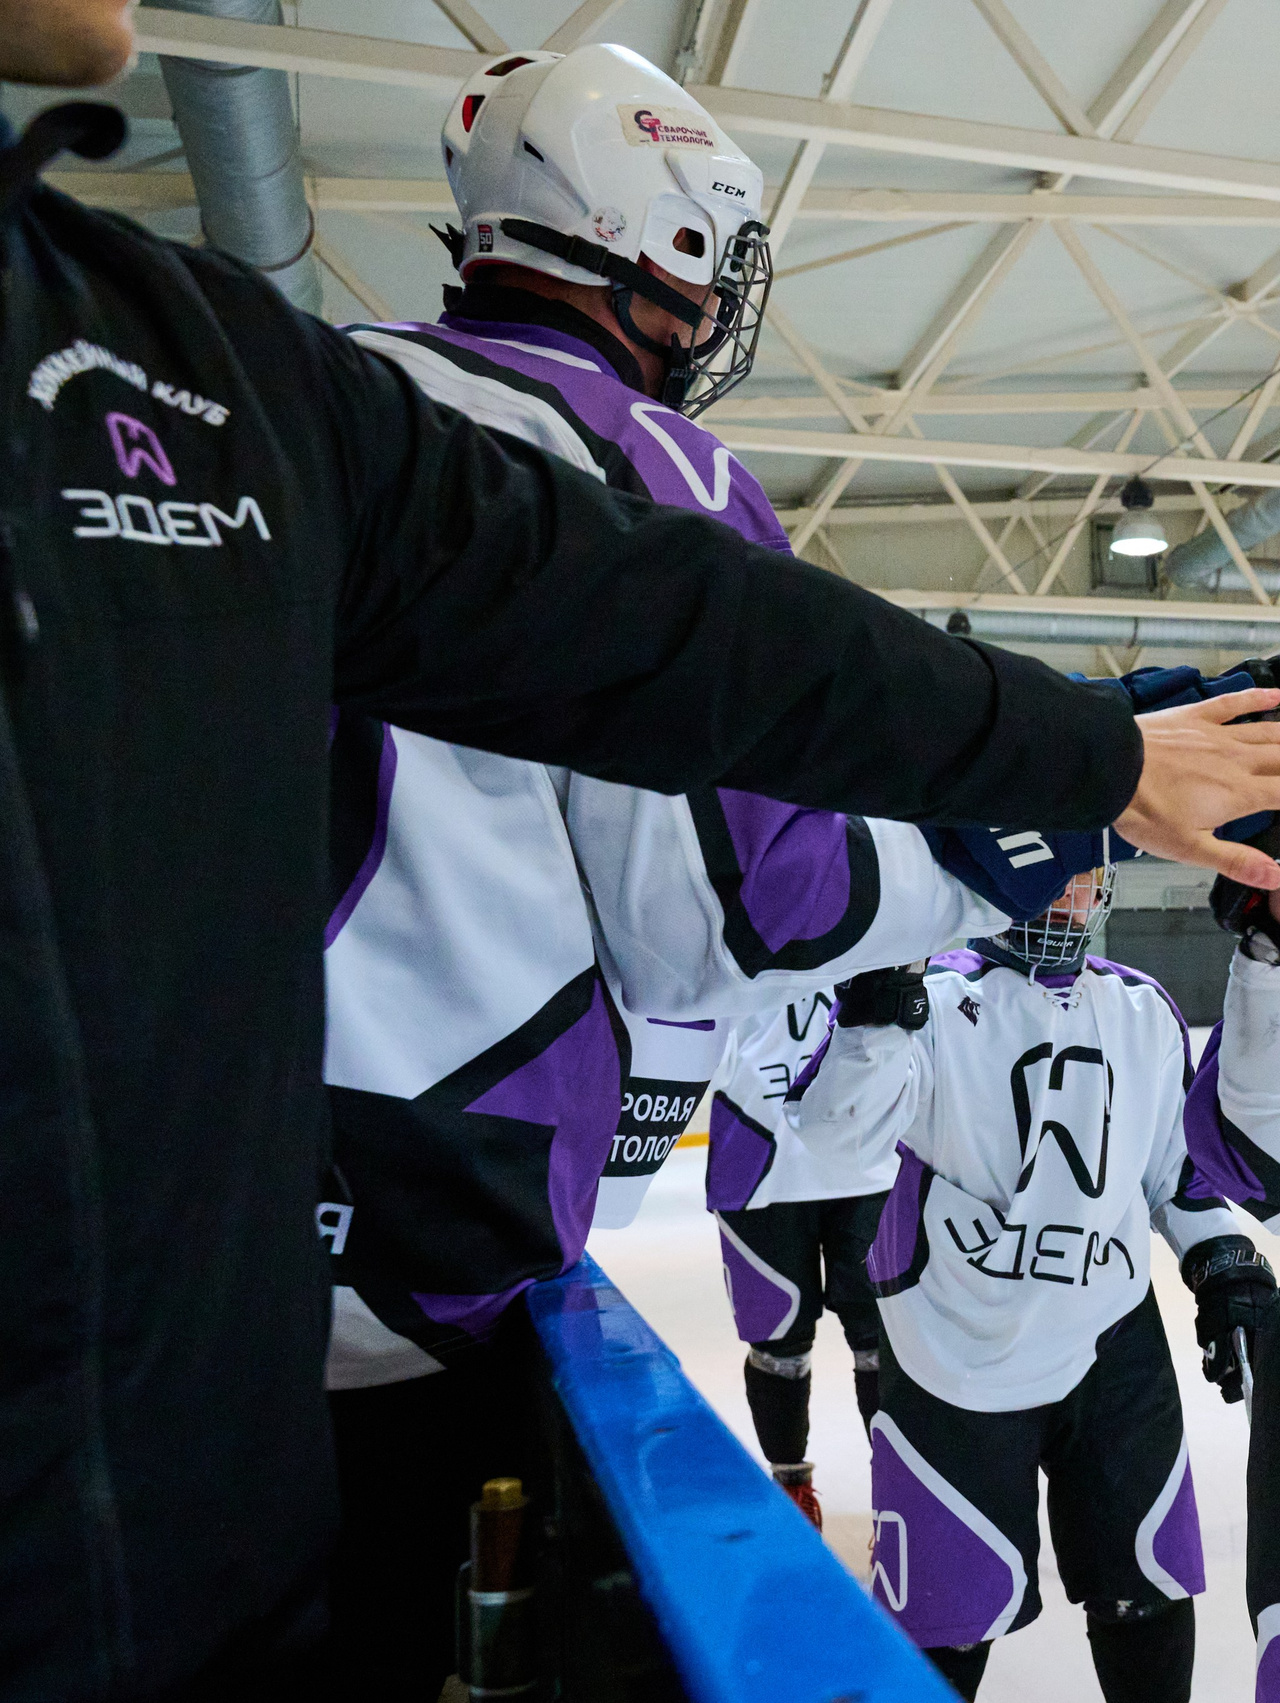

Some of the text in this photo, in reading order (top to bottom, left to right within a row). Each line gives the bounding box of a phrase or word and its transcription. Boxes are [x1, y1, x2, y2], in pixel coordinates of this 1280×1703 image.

[660, 134, 714, 149] ТЕХНОЛОГИИ
[711, 180, 747, 199] CCM
[61, 488, 271, 547] ЭДЕМ
